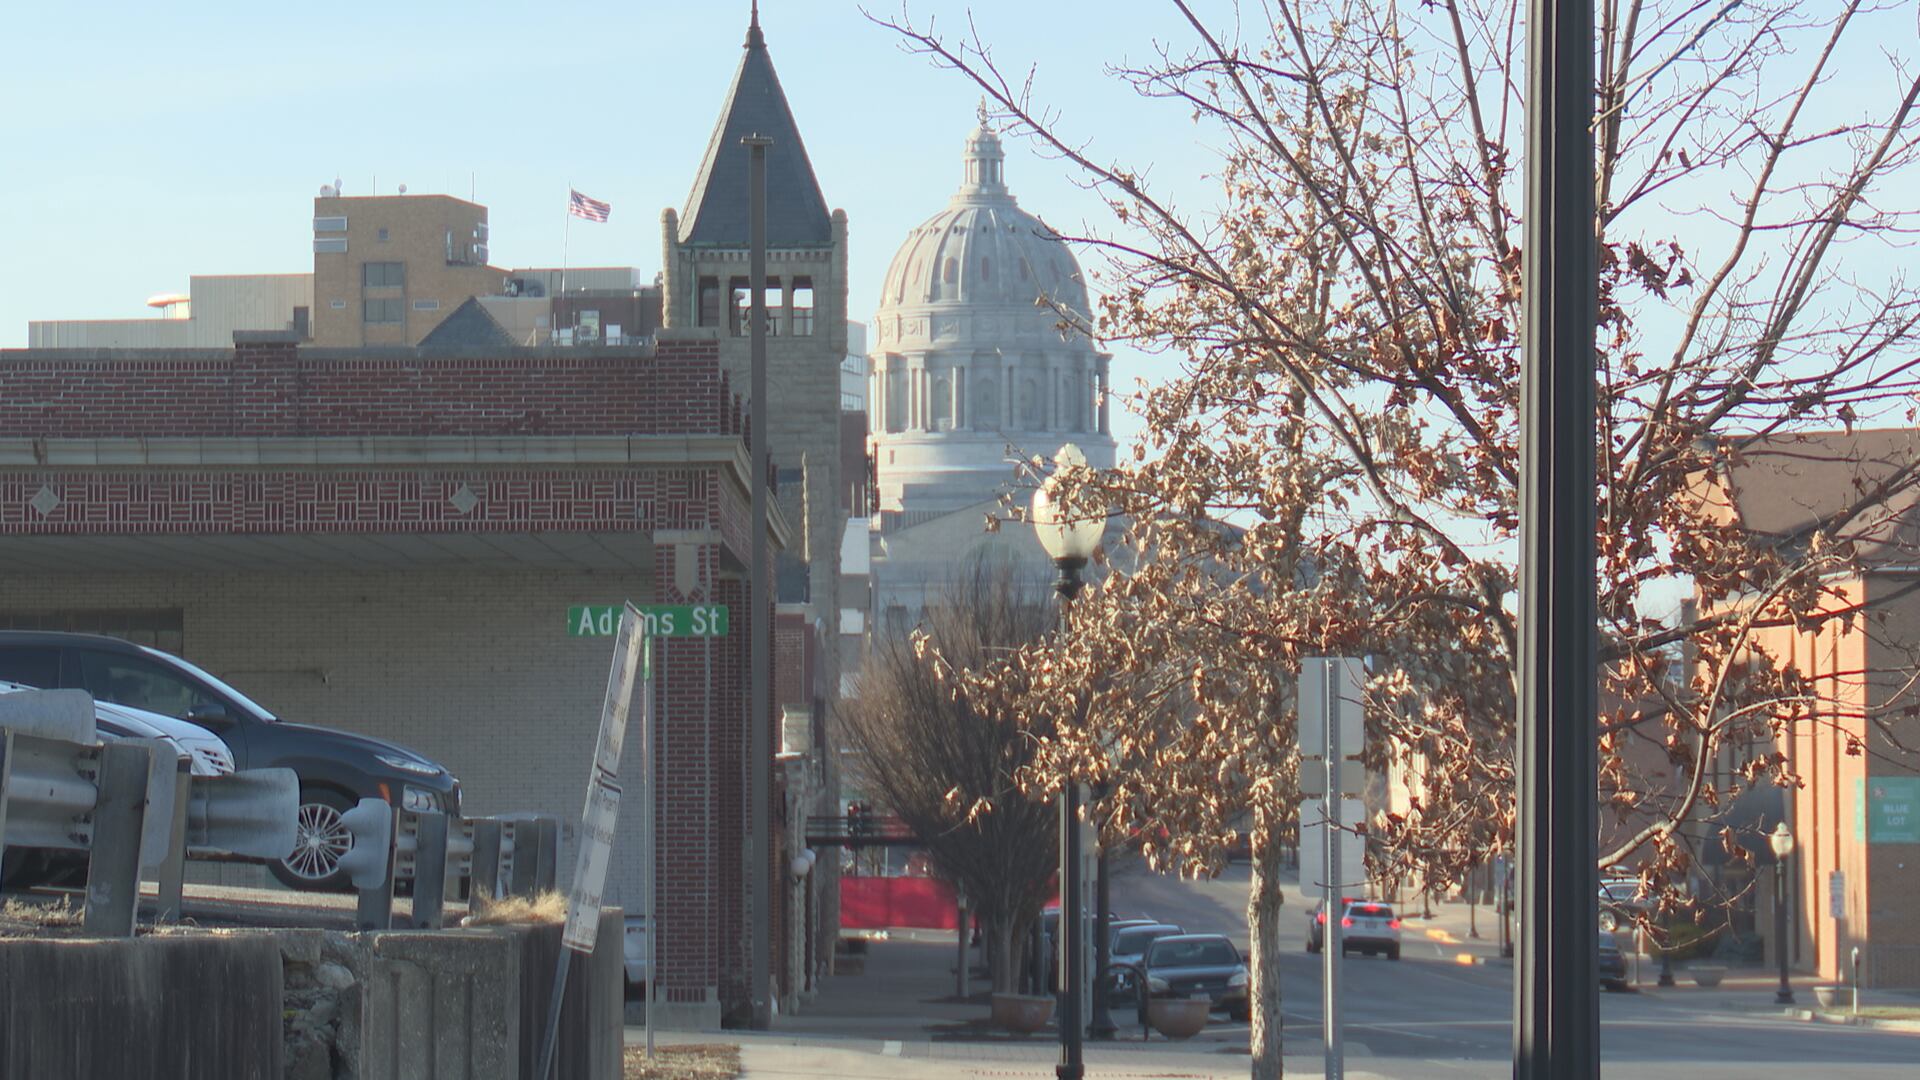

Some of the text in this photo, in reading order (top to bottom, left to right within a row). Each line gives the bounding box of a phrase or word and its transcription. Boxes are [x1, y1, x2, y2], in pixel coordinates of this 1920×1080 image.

[578, 606, 719, 635] Adms St
[1883, 804, 1910, 813] BLUE
[1887, 816, 1906, 826] LOT
